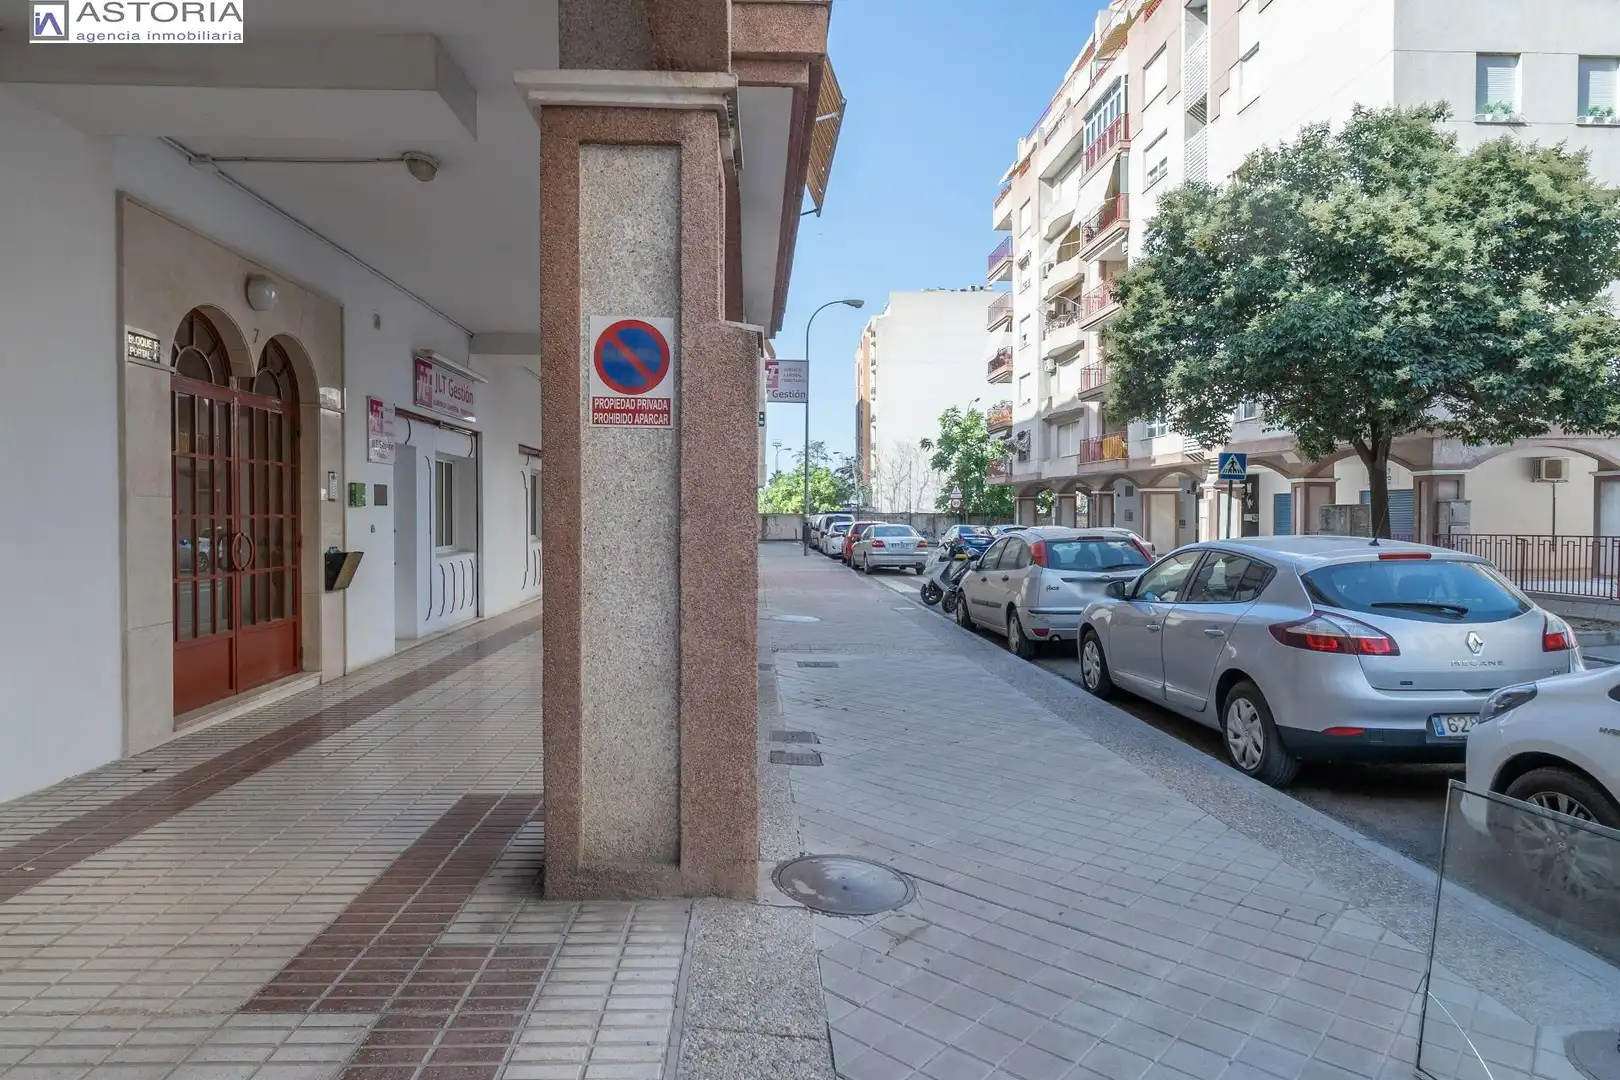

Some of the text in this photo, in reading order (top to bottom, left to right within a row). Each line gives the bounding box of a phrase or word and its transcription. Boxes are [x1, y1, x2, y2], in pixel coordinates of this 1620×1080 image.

[128, 334, 152, 349] BLOQUE
[253, 327, 260, 344] 7
[434, 372, 474, 406] JLT Gestión
[772, 389, 806, 399] Gestión
[594, 398, 669, 411] PROPIEDAD PRIVADA
[593, 412, 669, 425] PROHIBIDO APARCAR
[1450, 659, 1505, 667] MEGANE
